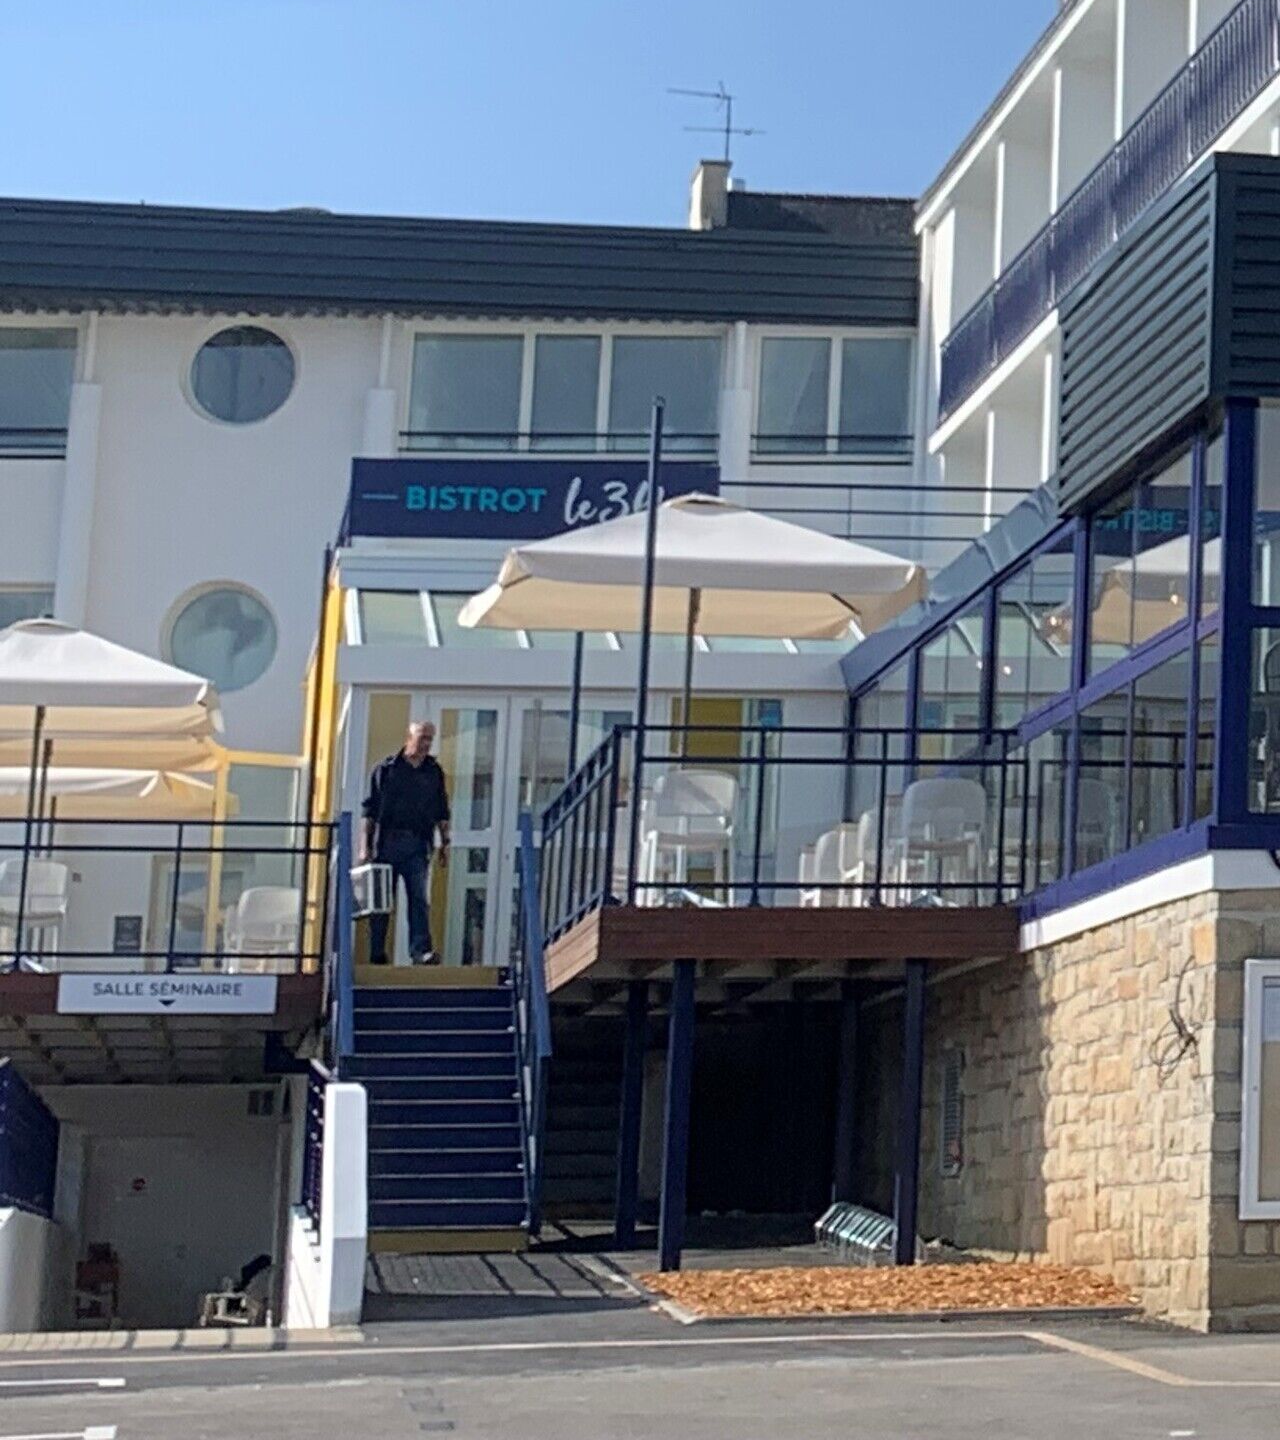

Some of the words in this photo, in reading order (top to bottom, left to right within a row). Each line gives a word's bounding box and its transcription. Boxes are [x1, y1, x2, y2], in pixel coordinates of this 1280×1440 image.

[406, 486, 547, 512] BISTROT
[93, 982, 143, 996] SALLE
[150, 981, 243, 996] SÉMINAIRE
